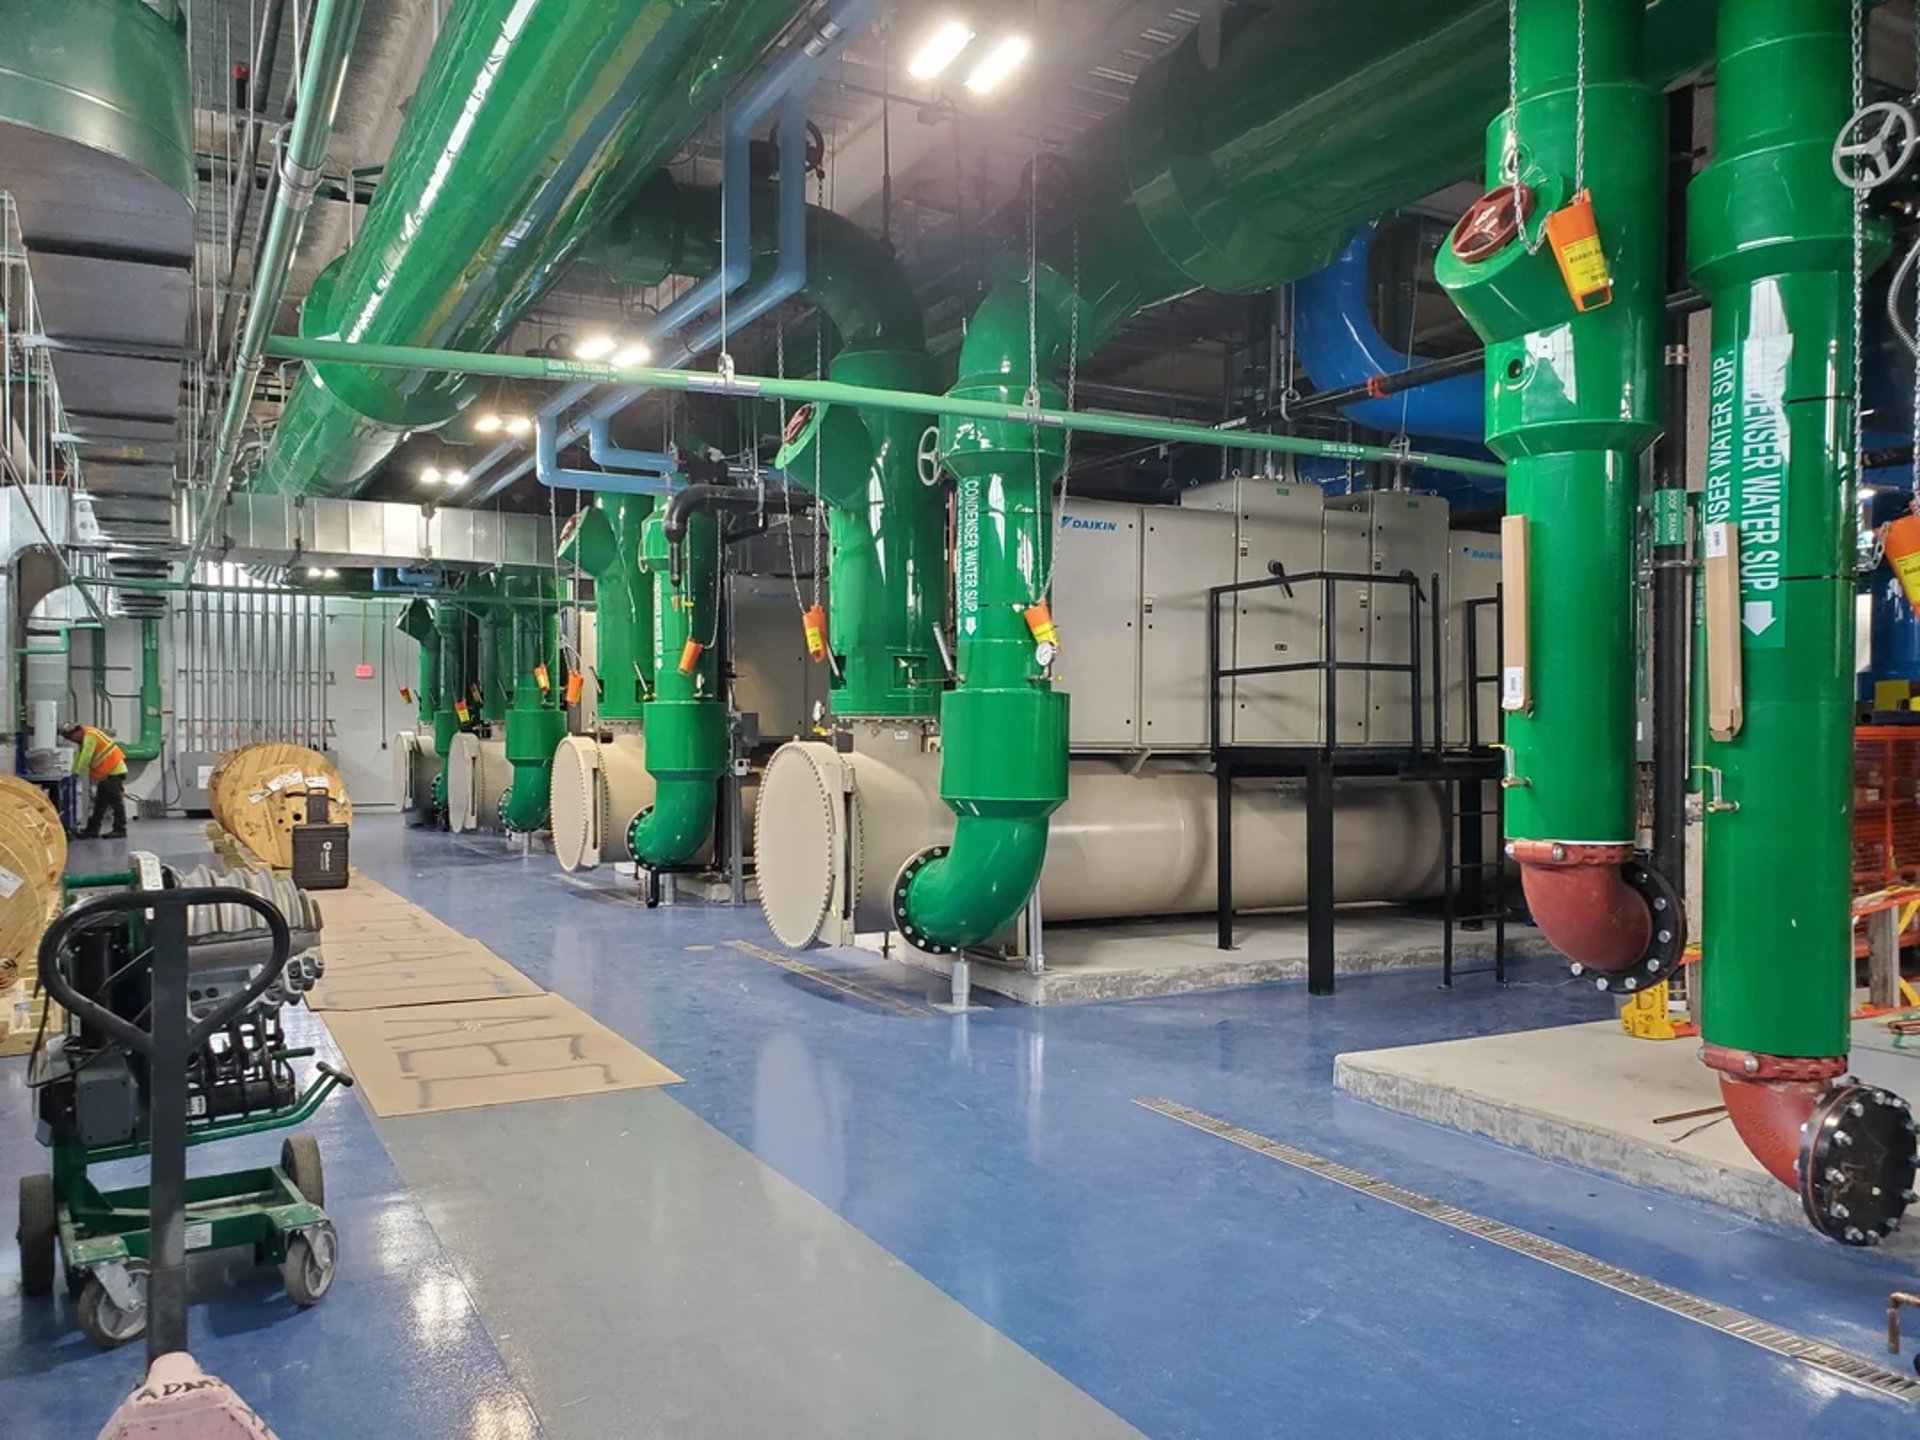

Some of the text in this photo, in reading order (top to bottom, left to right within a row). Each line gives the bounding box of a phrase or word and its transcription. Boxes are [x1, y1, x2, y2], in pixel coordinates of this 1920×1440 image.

[1708, 398, 1733, 471] WATER
[964, 479, 979, 548] CONDENSER
[1072, 519, 1117, 531] DAIKIN
[1741, 473, 1781, 546] WATER
[964, 550, 979, 588] WATER
